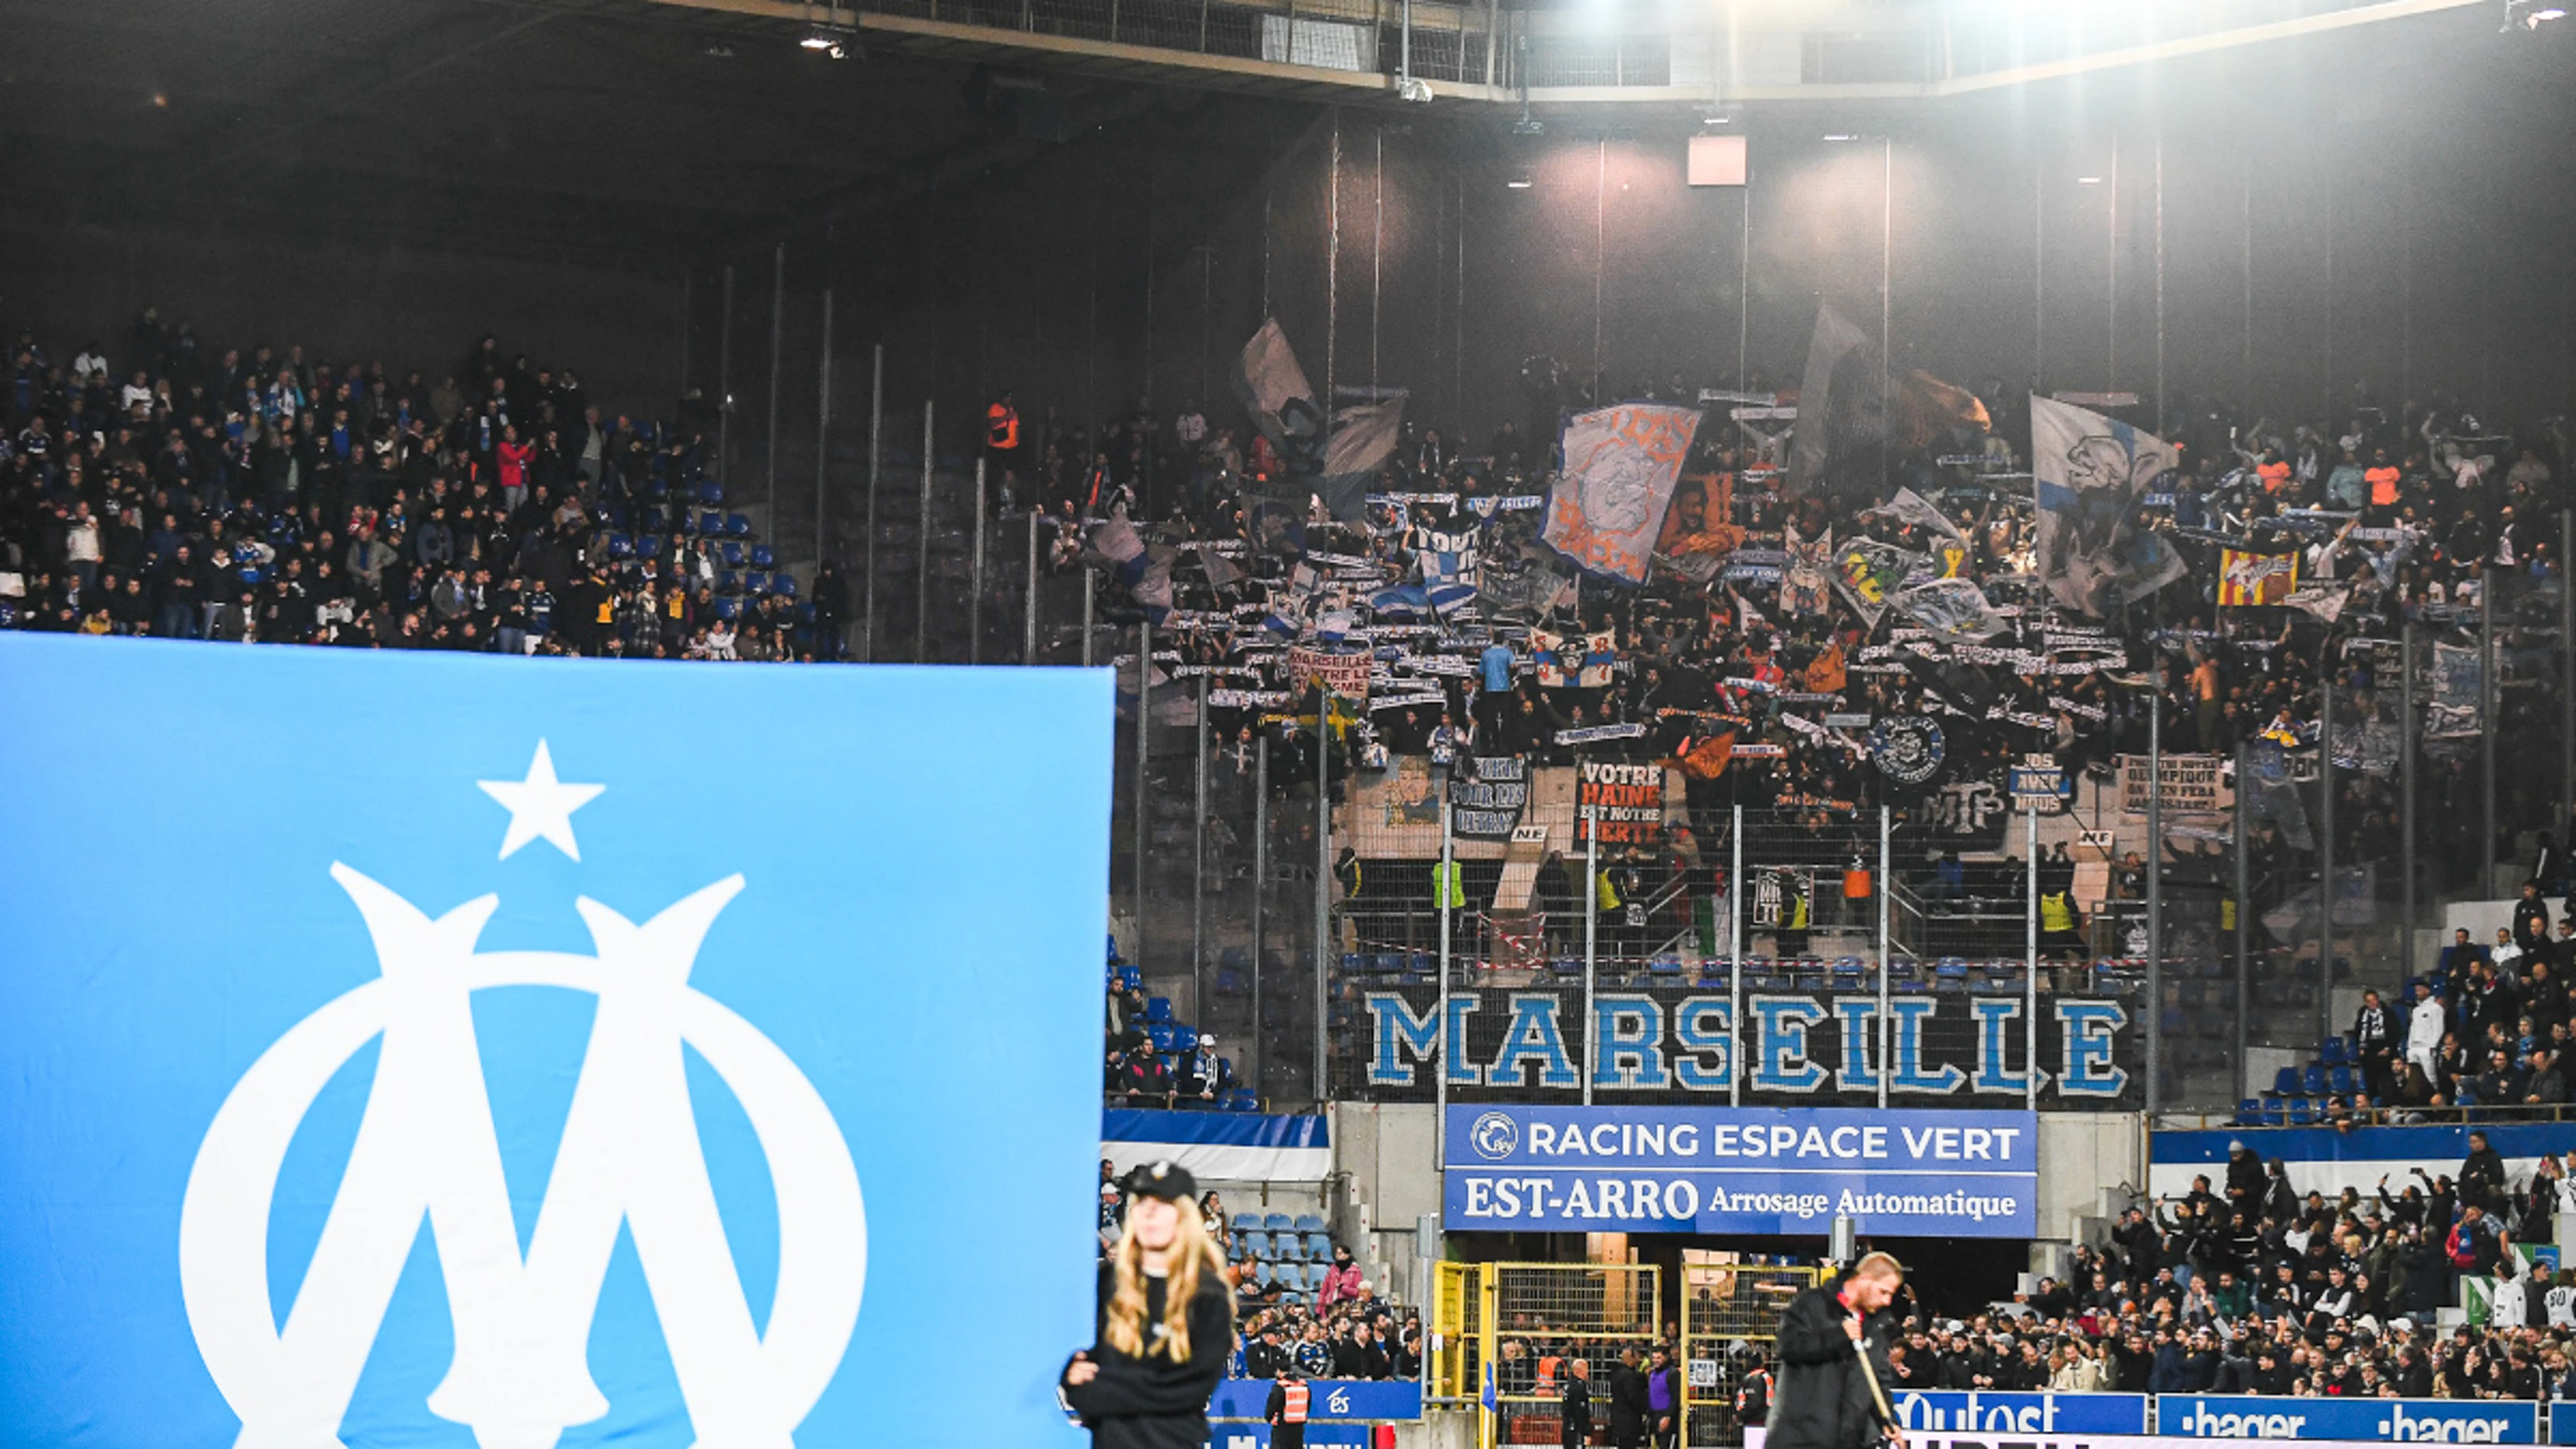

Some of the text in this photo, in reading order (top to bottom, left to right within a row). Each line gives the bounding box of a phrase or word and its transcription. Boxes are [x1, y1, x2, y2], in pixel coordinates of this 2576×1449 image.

[1290, 652, 1372, 667] MARSEILLE
[1584, 763, 1662, 786] VOTRE
[1582, 783, 1660, 806] HAINE
[1364, 991, 2129, 1097] MARSEILLE
[1527, 1124, 2021, 1161] RACING ESPACE VERT
[1464, 1177, 2017, 1222] EST-ARRO Arrosage Automatique
